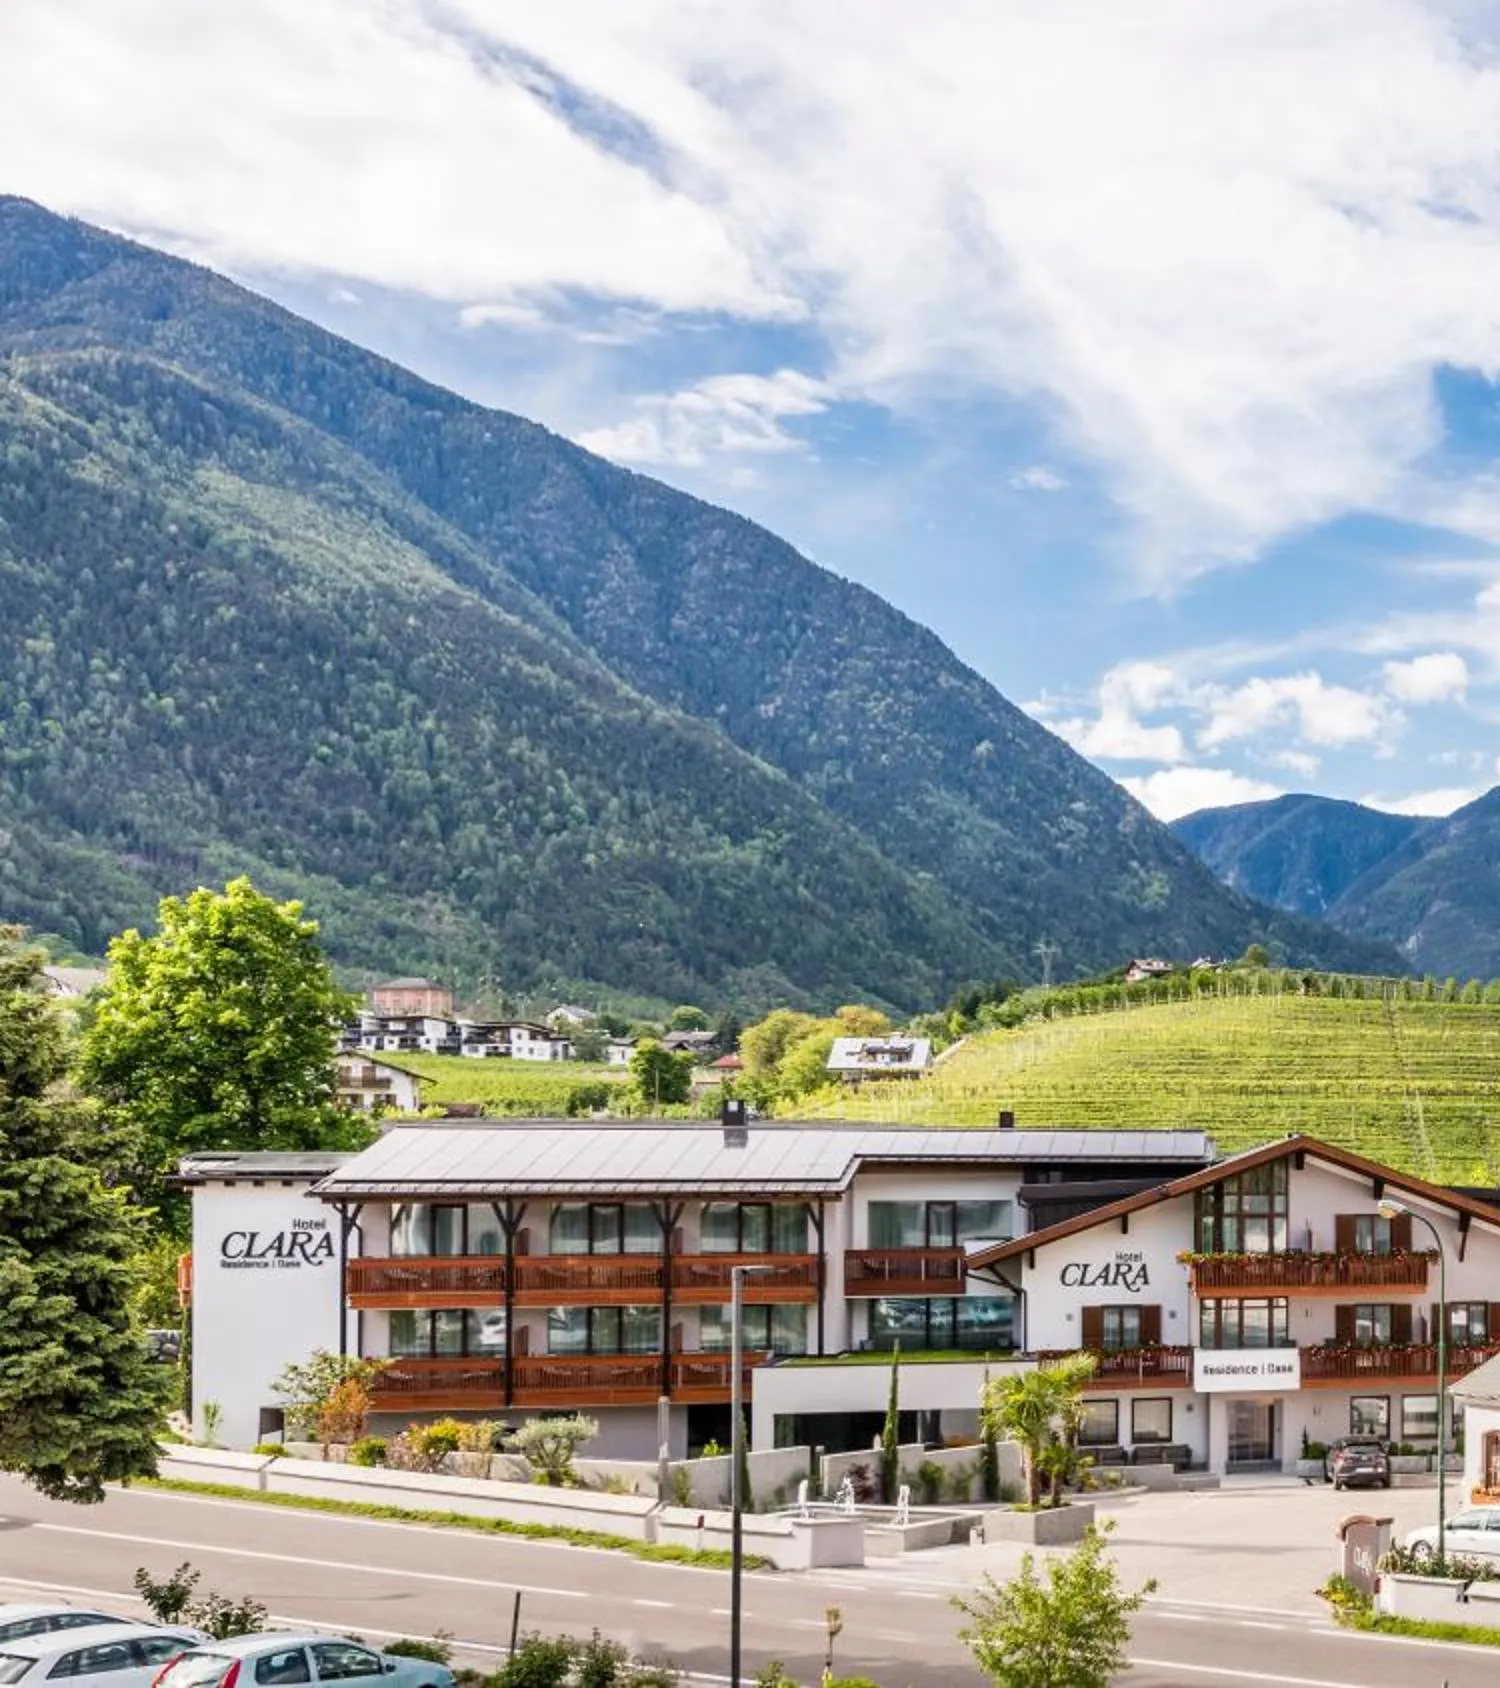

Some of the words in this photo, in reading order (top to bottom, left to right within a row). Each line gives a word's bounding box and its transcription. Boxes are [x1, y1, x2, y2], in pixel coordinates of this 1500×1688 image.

[293, 1218, 326, 1230] Hotel
[221, 1231, 335, 1266] CLARA
[1115, 1252, 1142, 1262] Hotel
[1060, 1263, 1150, 1292] CLARA
